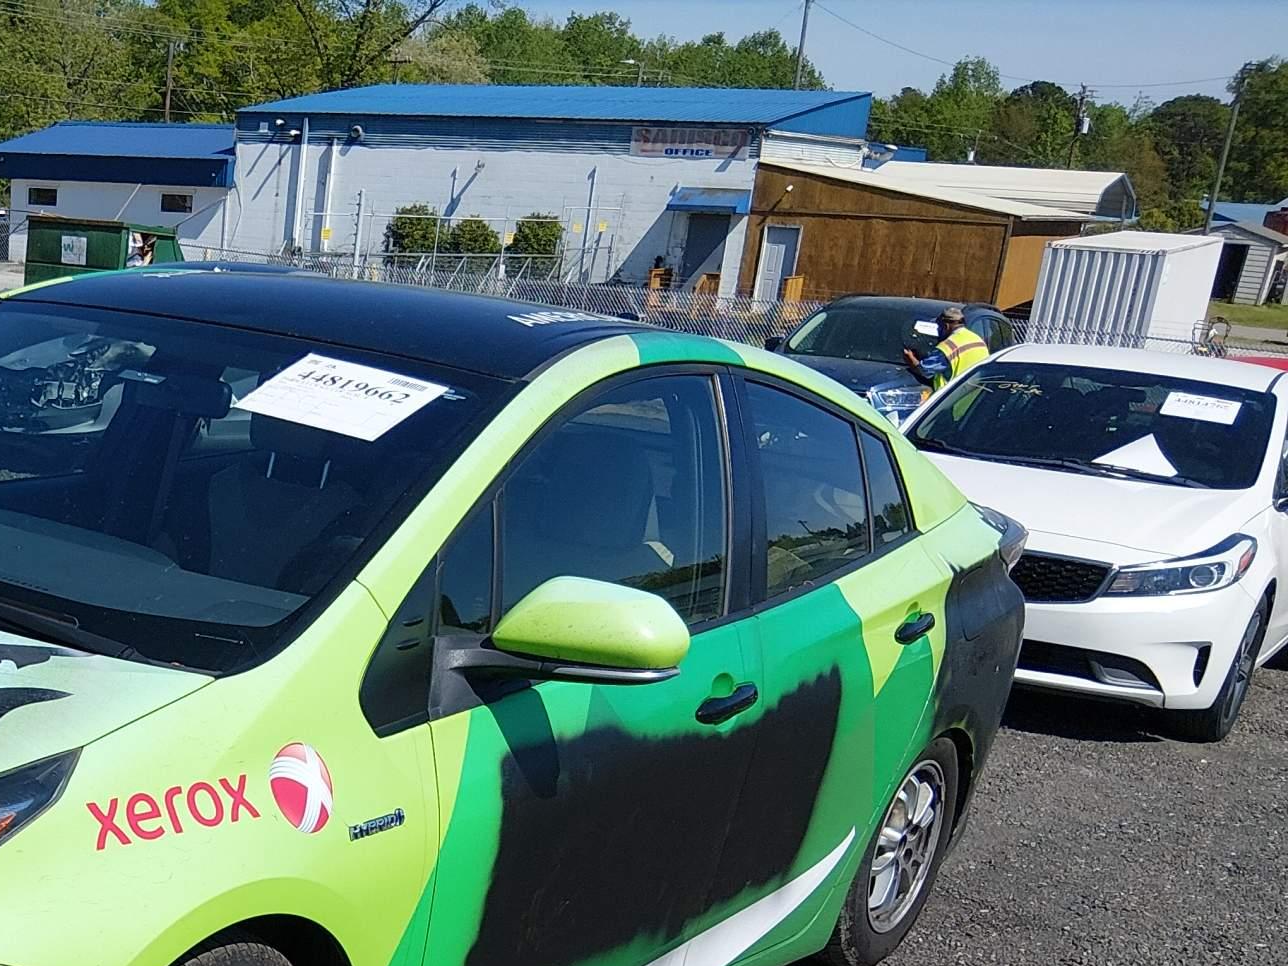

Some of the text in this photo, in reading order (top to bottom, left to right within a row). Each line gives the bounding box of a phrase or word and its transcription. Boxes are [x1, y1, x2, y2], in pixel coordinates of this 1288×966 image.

[664, 148, 713, 157] OFFICE
[298, 369, 413, 406] 44819662
[86, 773, 262, 851] xerox
[349, 813, 400, 841] HYBRID
